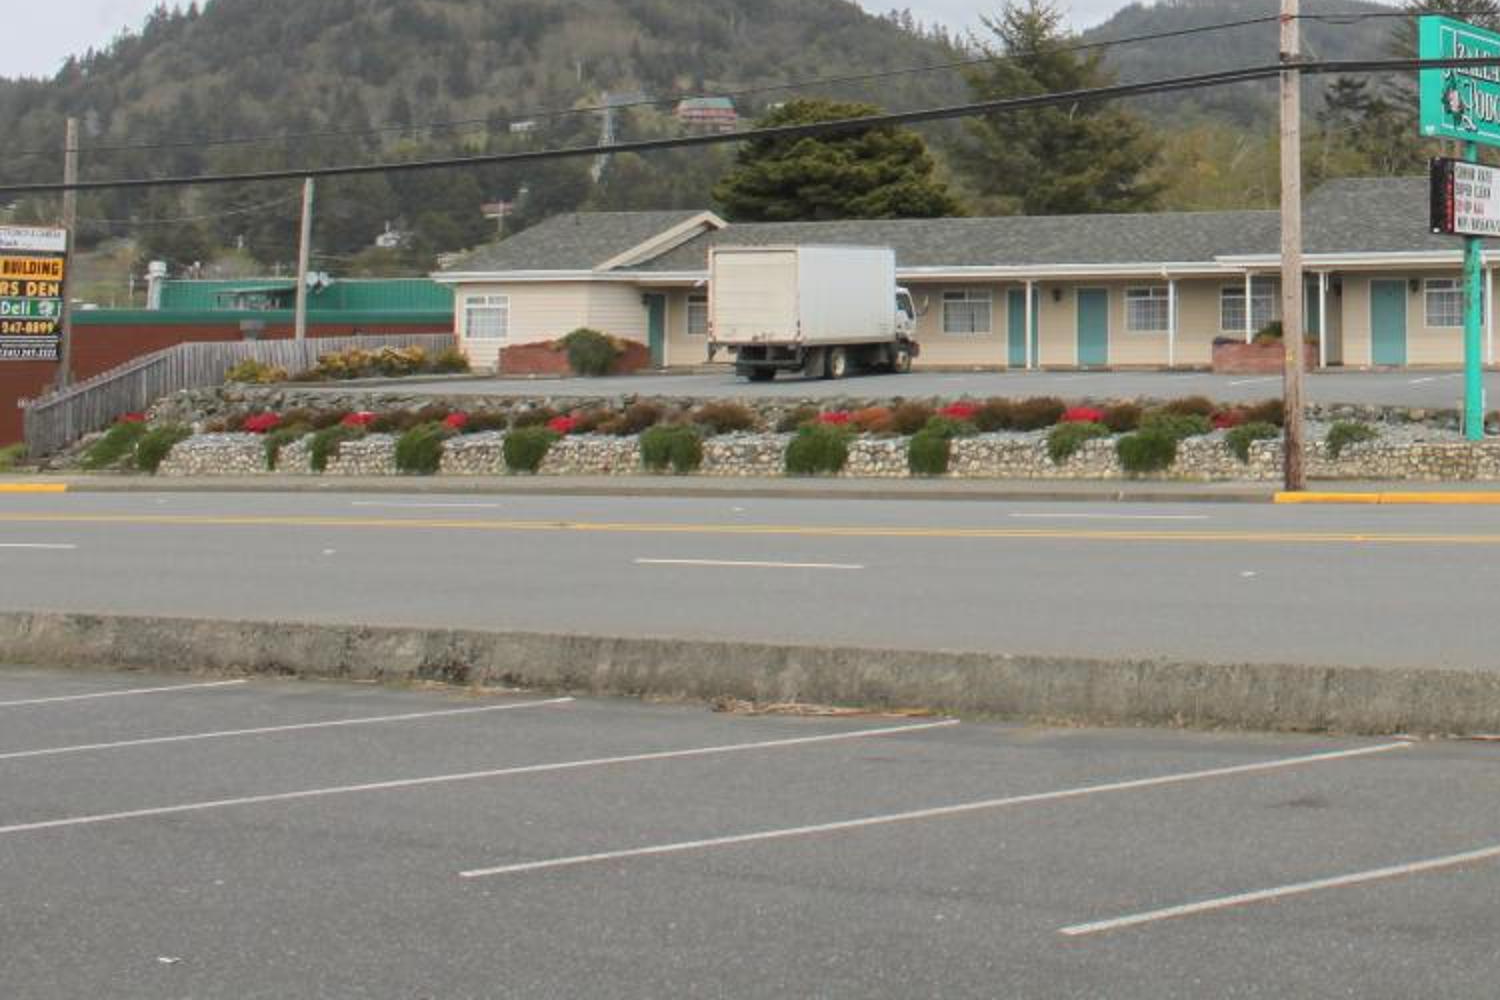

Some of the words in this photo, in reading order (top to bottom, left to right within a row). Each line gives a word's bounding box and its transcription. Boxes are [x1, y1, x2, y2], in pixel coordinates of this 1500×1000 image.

[3, 260, 60, 276] BUILDING
[26, 281, 59, 297] DEN
[1, 301, 31, 315] Deli
